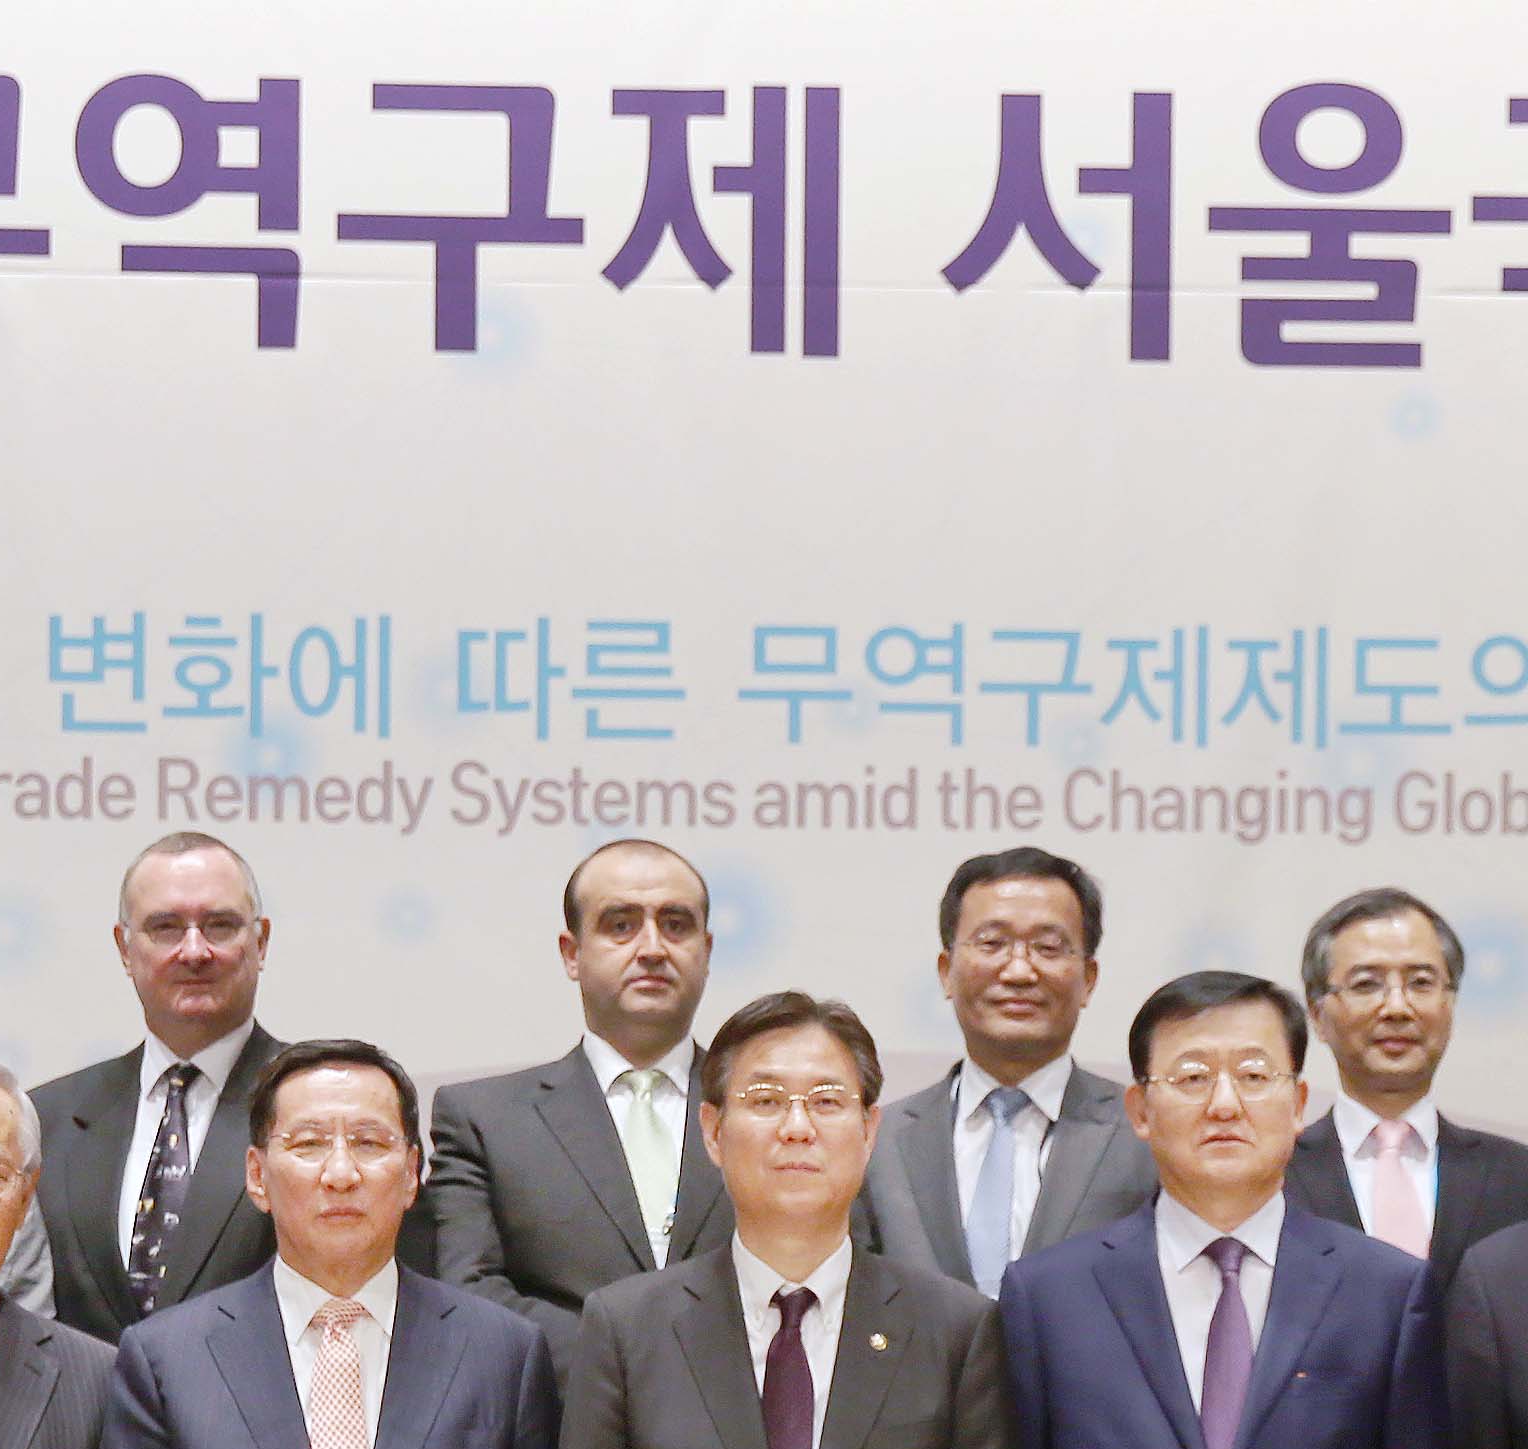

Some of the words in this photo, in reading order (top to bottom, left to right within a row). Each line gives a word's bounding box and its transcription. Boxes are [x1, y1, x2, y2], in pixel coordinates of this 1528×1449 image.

[48, 613, 392, 740] 변화에
[457, 619, 686, 740] 따른
[156, 756, 434, 836] Remedy
[450, 760, 737, 836] Systems
[753, 766, 918, 830] amid
[938, 767, 1043, 831] the
[1063, 767, 1372, 845] Changing
